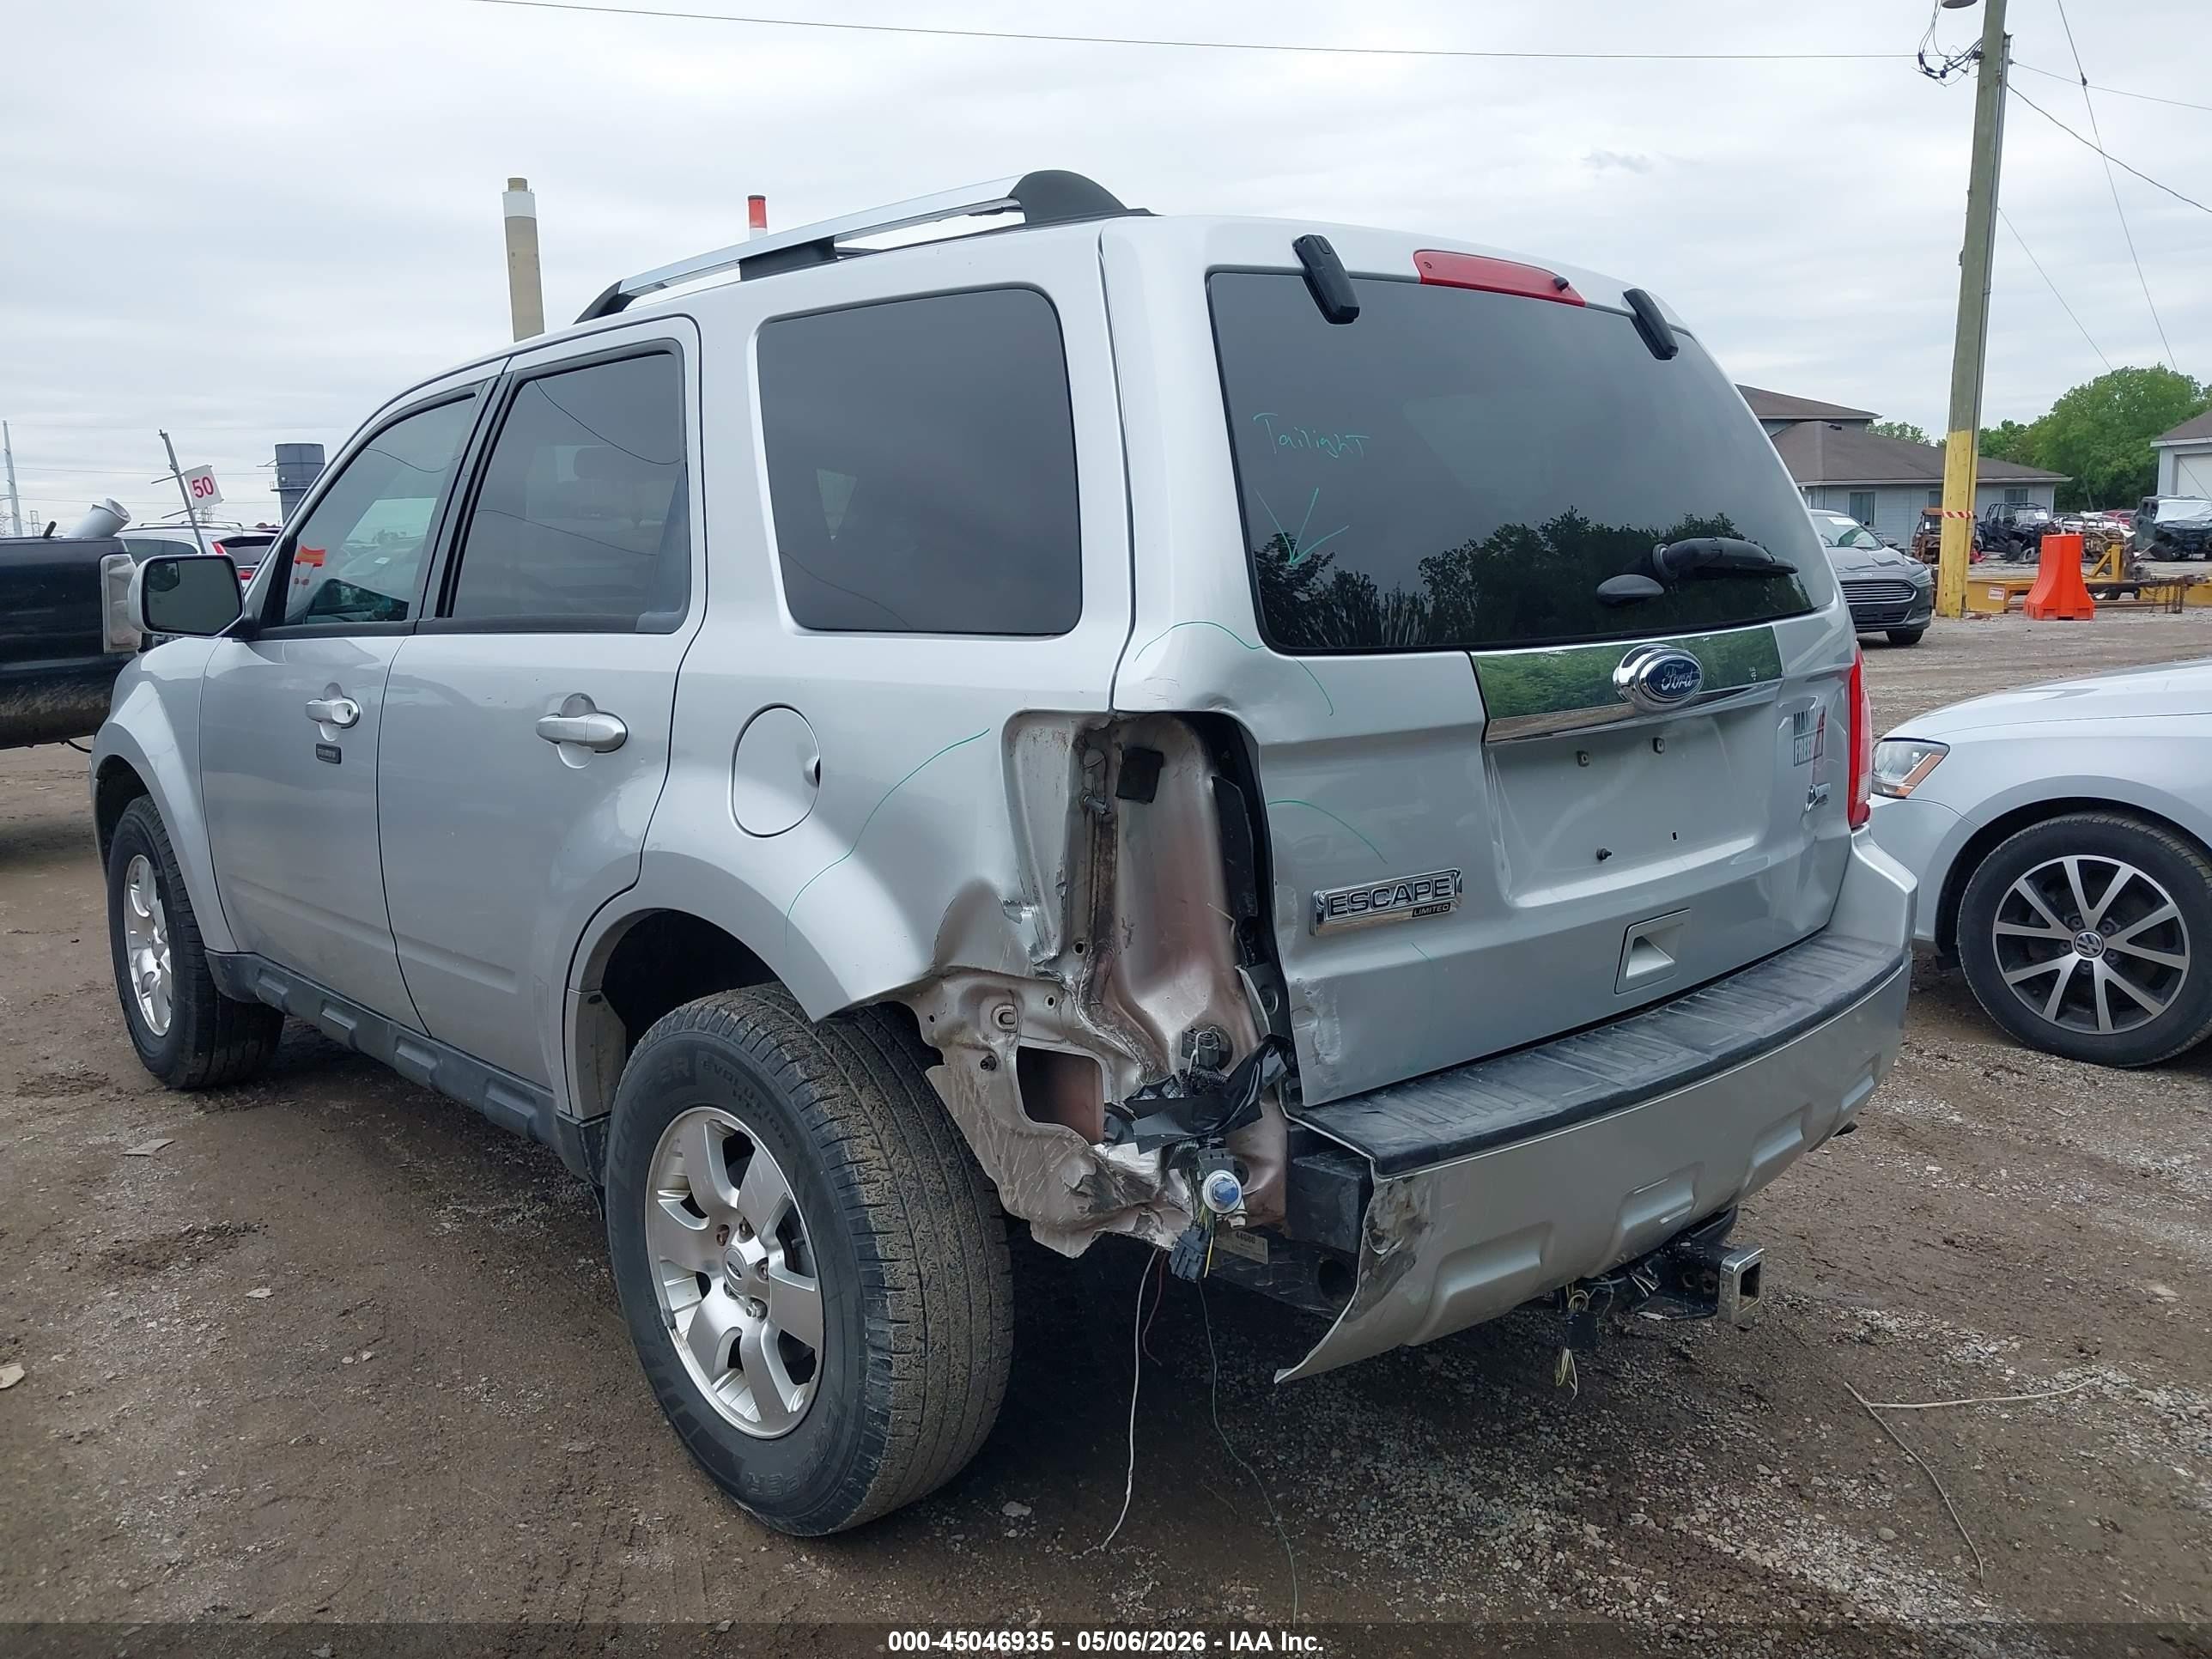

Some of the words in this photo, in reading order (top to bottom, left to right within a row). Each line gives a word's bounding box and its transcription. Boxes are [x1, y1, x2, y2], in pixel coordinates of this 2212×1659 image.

[191, 476, 215, 499] 50
[1661, 662, 1697, 692] Ford
[1328, 875, 1453, 919] ESCAPE
[1413, 902, 1451, 917] LIMITED
